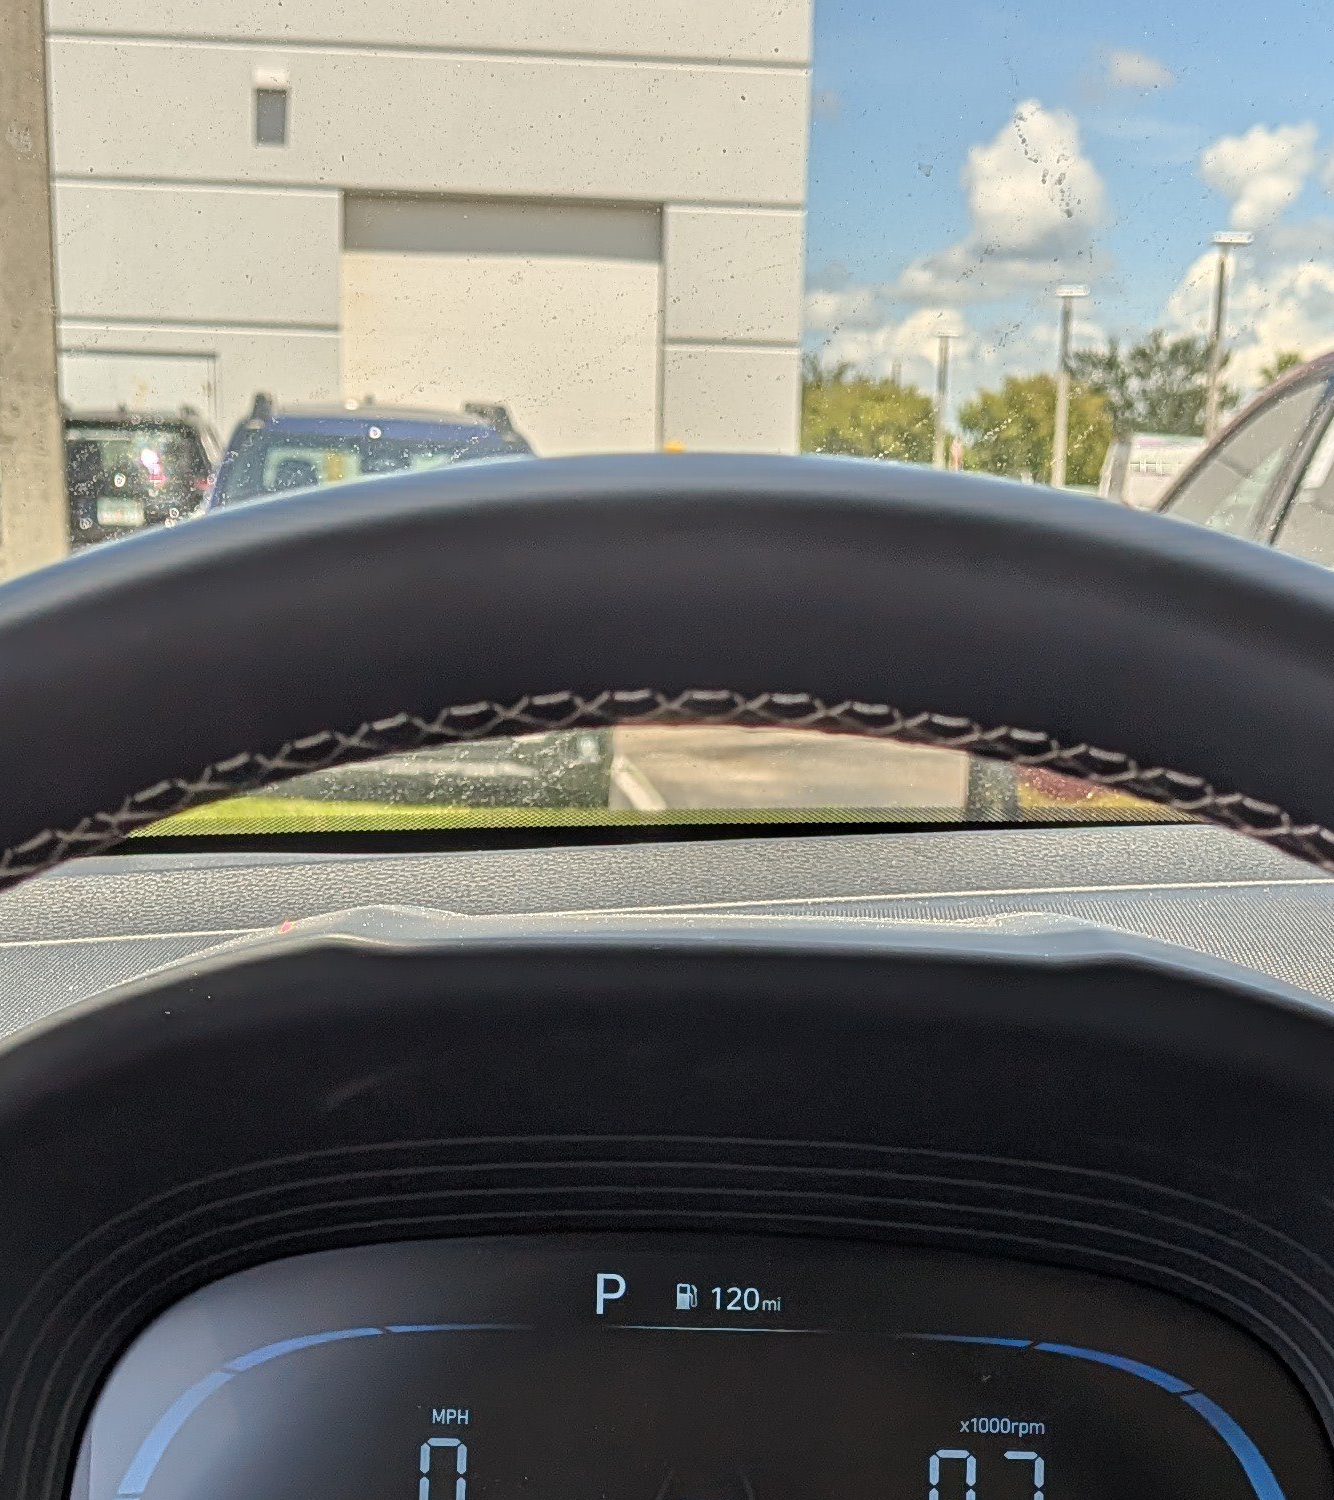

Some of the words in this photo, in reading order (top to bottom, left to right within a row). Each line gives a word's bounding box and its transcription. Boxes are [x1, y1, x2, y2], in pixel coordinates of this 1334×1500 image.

[596, 1273, 627, 1315] P
[431, 1408, 469, 1425] MPH
[959, 1417, 1046, 1438] x1000rpm
